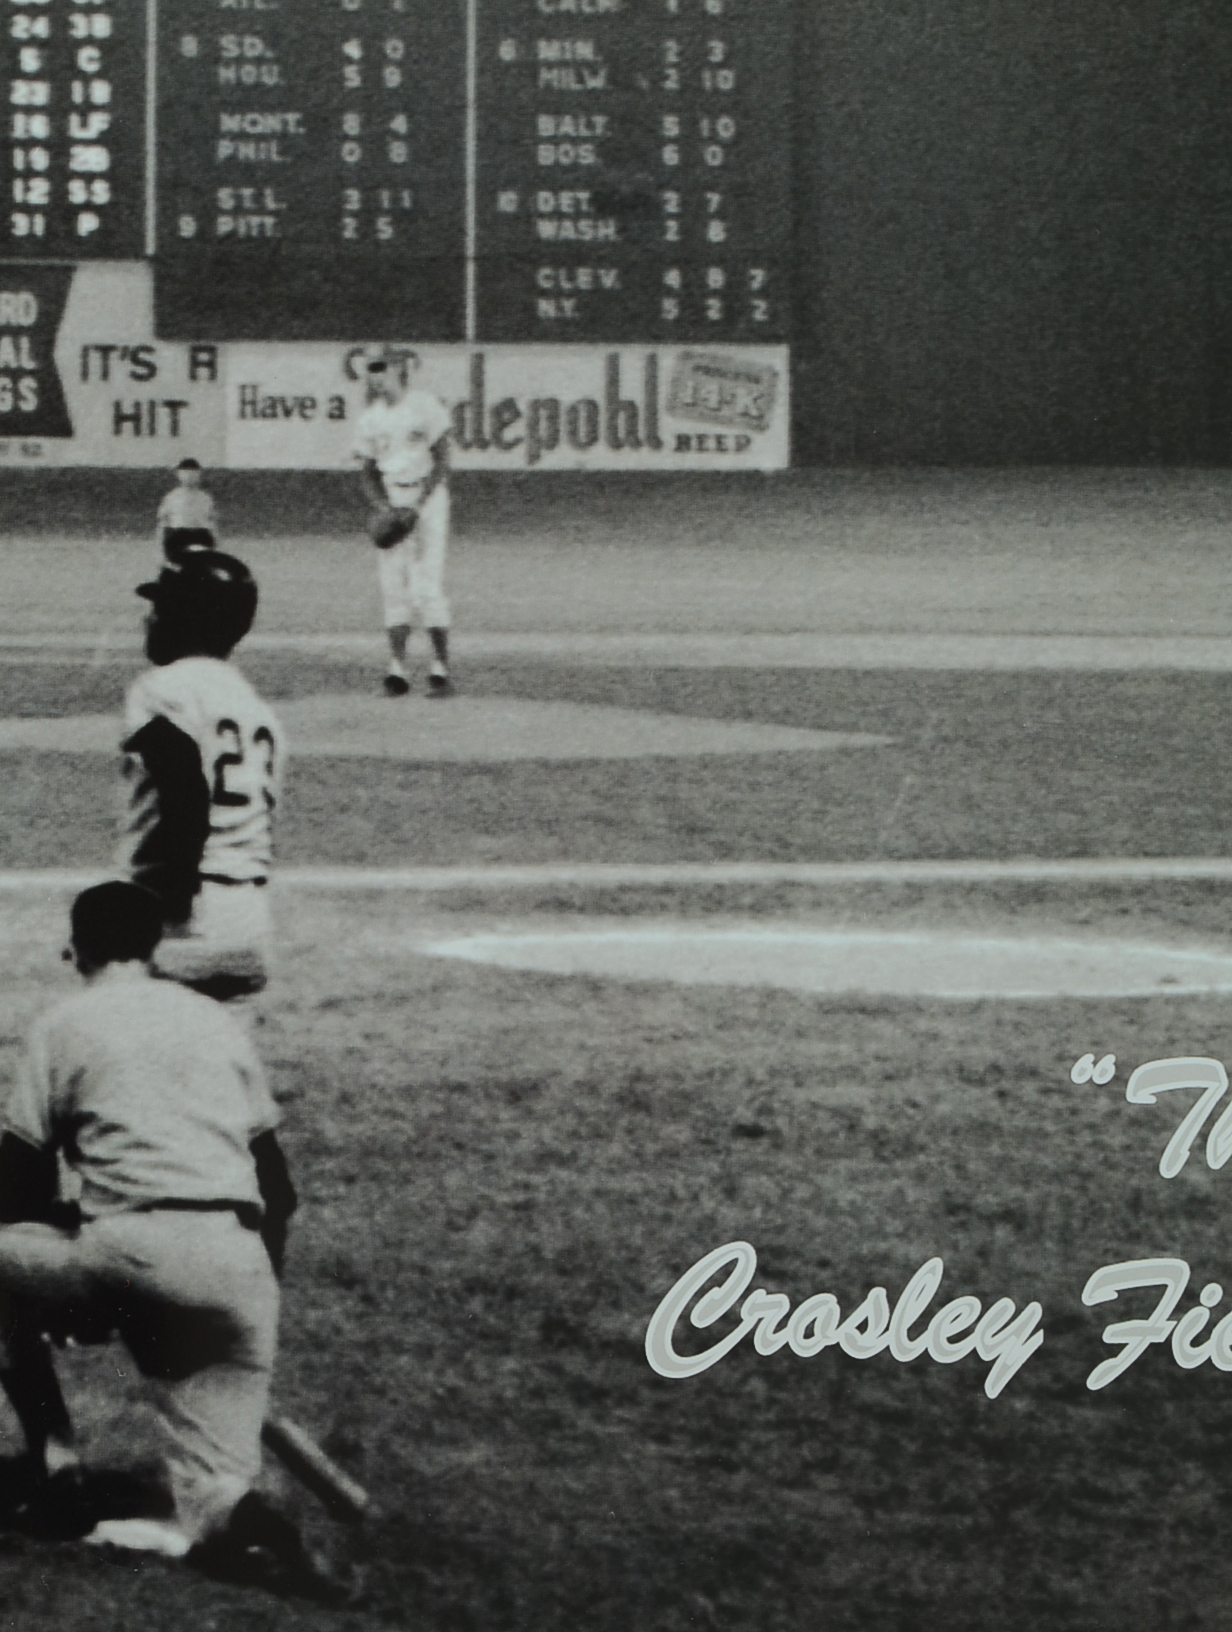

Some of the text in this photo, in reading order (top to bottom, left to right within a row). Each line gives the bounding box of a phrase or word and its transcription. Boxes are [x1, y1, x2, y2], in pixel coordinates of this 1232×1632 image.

[11, 15, 49, 39] 24
[77, 46, 100, 73] C
[343, 39, 362, 60] 4
[343, 64, 361, 88] 5
[702, 69, 735, 90] 10
[69, 112, 111, 139] LF
[389, 114, 408, 134] 4
[663, 115, 679, 137] 5
[700, 116, 735, 139] 10
[341, 142, 361, 163] 0
[662, 144, 679, 165] 6
[704, 145, 723, 166] 0
[13, 178, 110, 204] 12 SS
[706, 192, 721, 212] 7
[11, 213, 99, 236] 31 P
[377, 217, 393, 240] 5
[750, 269, 765, 290] 7
[80, 343, 158, 382] IT'S
[239, 384, 346, 420] Have a
[344, 347, 665, 466] depohl
[113, 400, 188, 437] HIT
